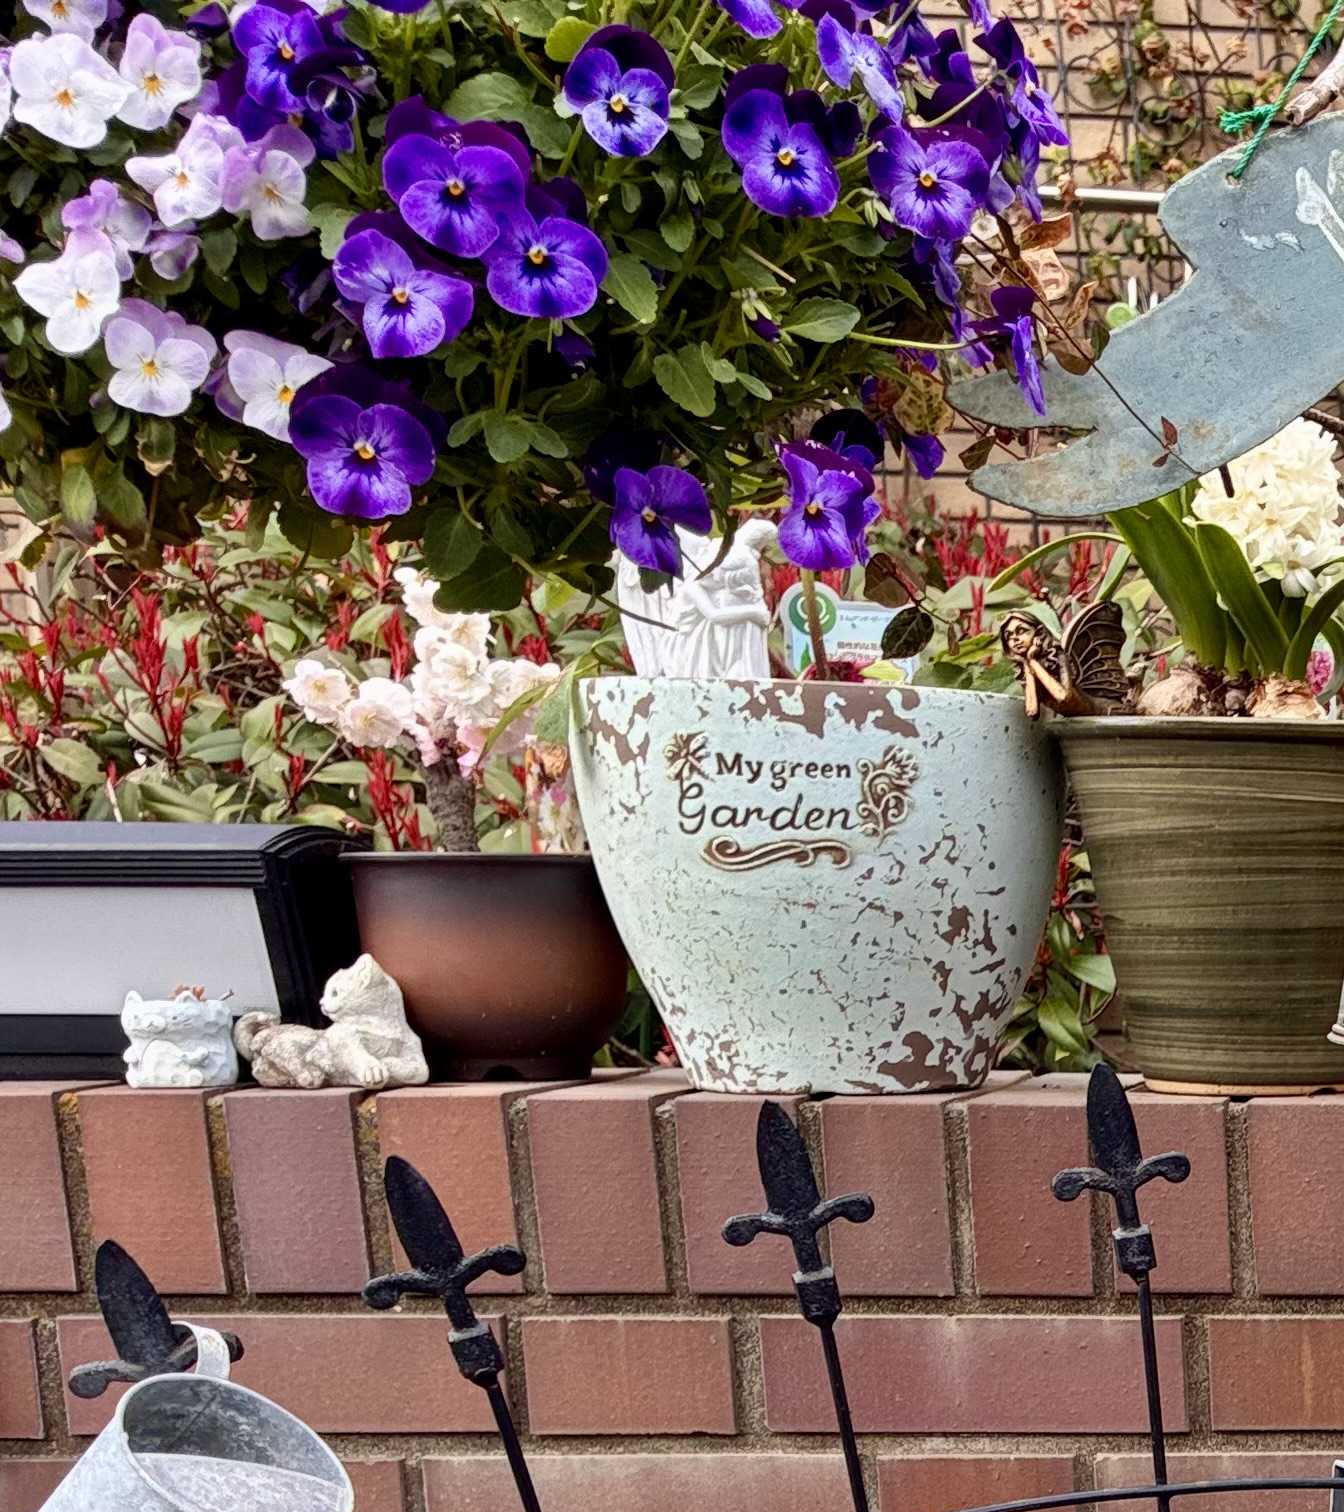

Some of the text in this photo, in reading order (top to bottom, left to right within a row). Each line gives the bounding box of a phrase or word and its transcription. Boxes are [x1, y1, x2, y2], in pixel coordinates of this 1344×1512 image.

[715, 752, 852, 792] My green
[677, 780, 859, 835] Garden
